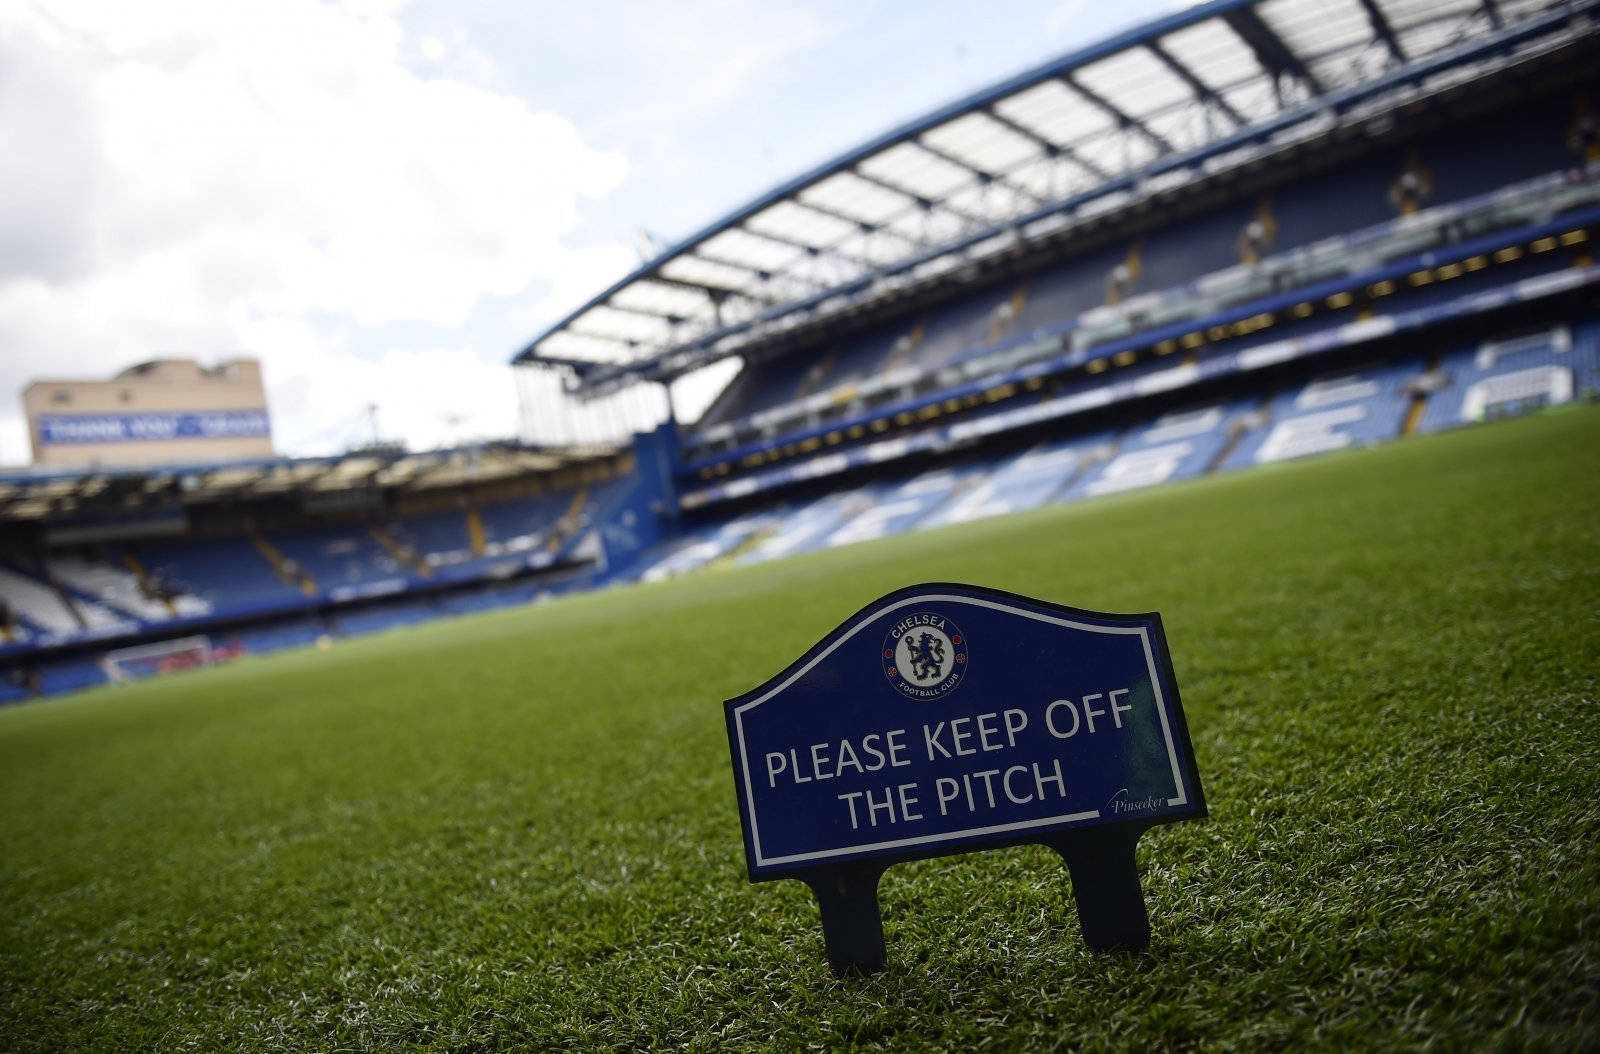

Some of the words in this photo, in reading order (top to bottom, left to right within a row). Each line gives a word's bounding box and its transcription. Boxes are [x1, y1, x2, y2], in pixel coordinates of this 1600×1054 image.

[891, 614, 945, 639] CHELSEA
[899, 682, 941, 697] FOOTBALL
[941, 673, 959, 692] CLUB
[765, 728, 912, 788] PLEASE
[922, 708, 1029, 761] KEEP
[1045, 687, 1133, 739] OFF
[837, 782, 924, 830] THE
[935, 758, 1067, 816] PITCH
[1110, 795, 1163, 813] Pinseeker
